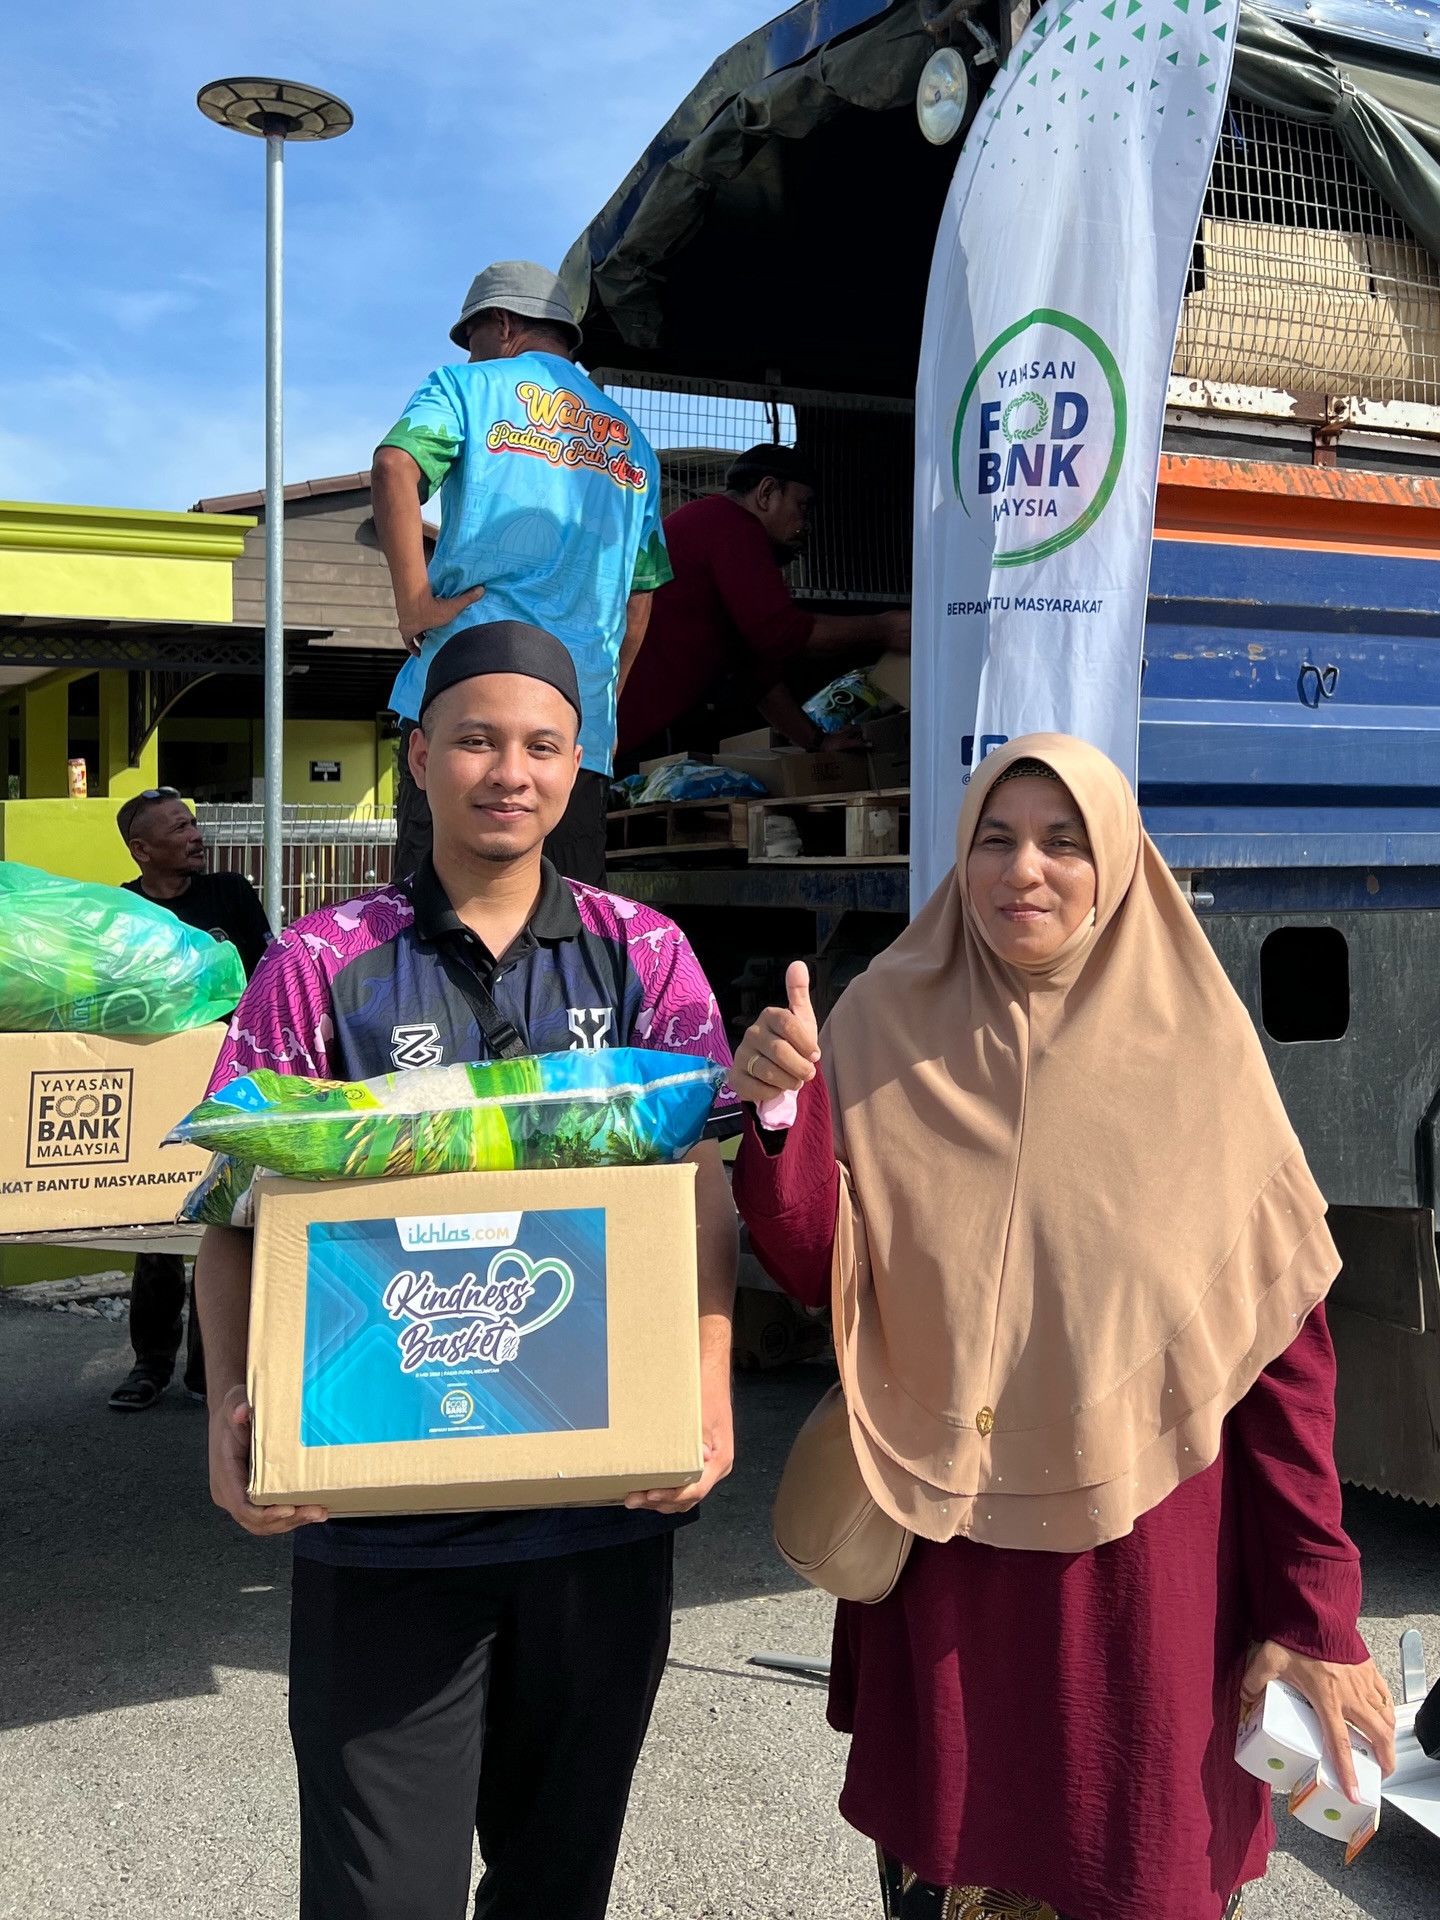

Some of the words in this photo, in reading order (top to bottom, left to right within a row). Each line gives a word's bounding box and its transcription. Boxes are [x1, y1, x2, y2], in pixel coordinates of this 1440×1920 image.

[516, 381, 629, 446] Warga
[487, 420, 563, 462] Padang
[564, 437, 608, 466] Pak
[977, 444, 1084, 495] BNK
[1014, 597, 1103, 614] MASYARAKAT
[41, 1078, 124, 1093] YAYASAN
[39, 1094, 122, 1119] FOOD
[37, 1118, 121, 1142] BANK
[37, 1142, 120, 1158] MALAYSIA
[37, 1178, 90, 1192] BANTU
[384, 1270, 532, 1321] Kindness
[401, 1321, 516, 1370] Basket
[445, 1407, 468, 1415] BANK
